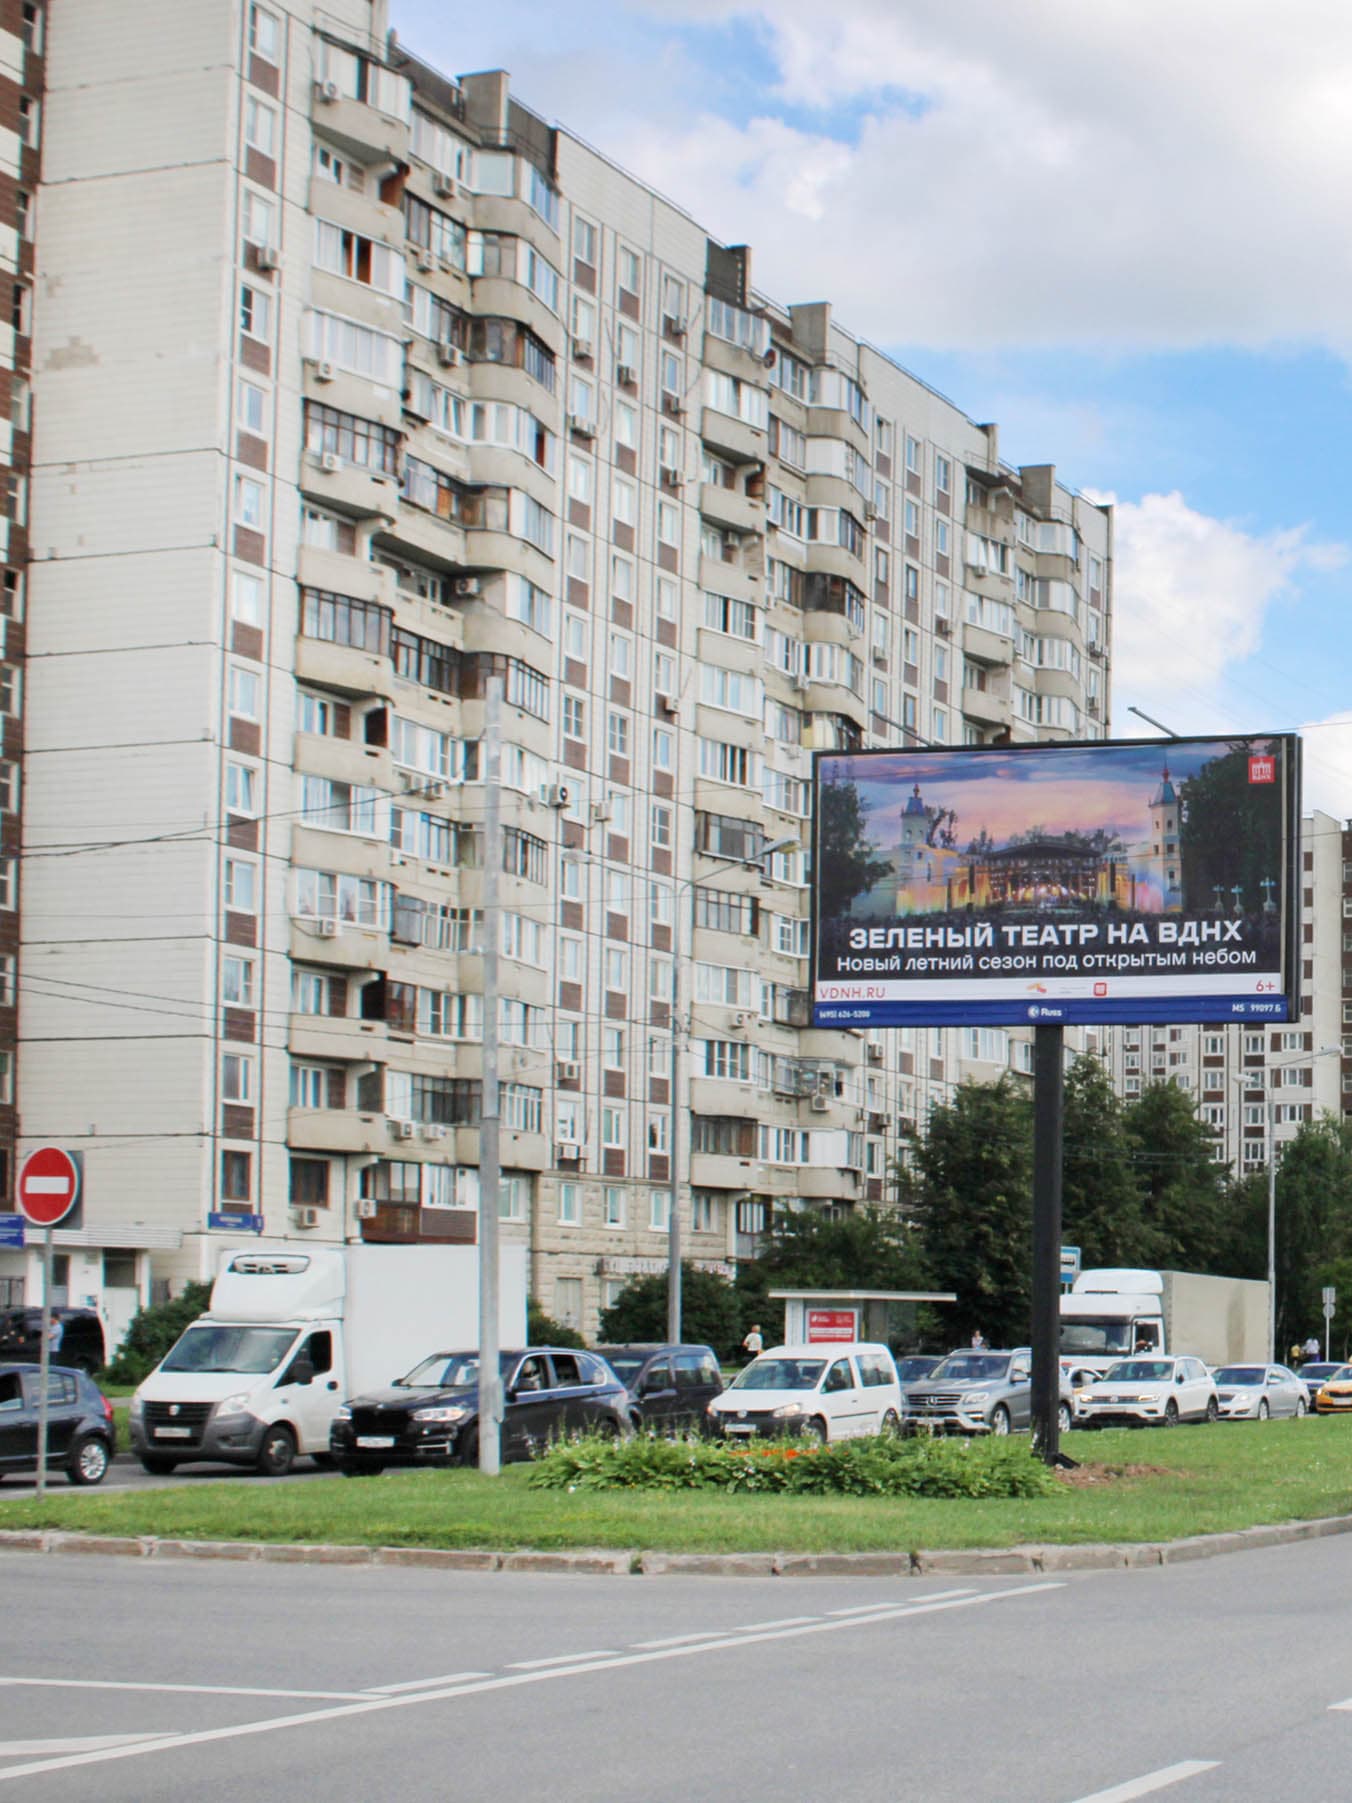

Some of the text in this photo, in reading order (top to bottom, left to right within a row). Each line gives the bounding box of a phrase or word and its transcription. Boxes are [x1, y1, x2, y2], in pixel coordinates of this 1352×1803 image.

[849, 919, 1243, 949] ЗЕЛЕНЫЙ ТЕАТР НА ВДНХ
[836, 947, 1257, 972] Новый летний сезон под открытым небом
[1255, 979, 1276, 992] 6+
[820, 986, 886, 999] VDNH.RU
[1040, 1007, 1063, 1017] Russ
